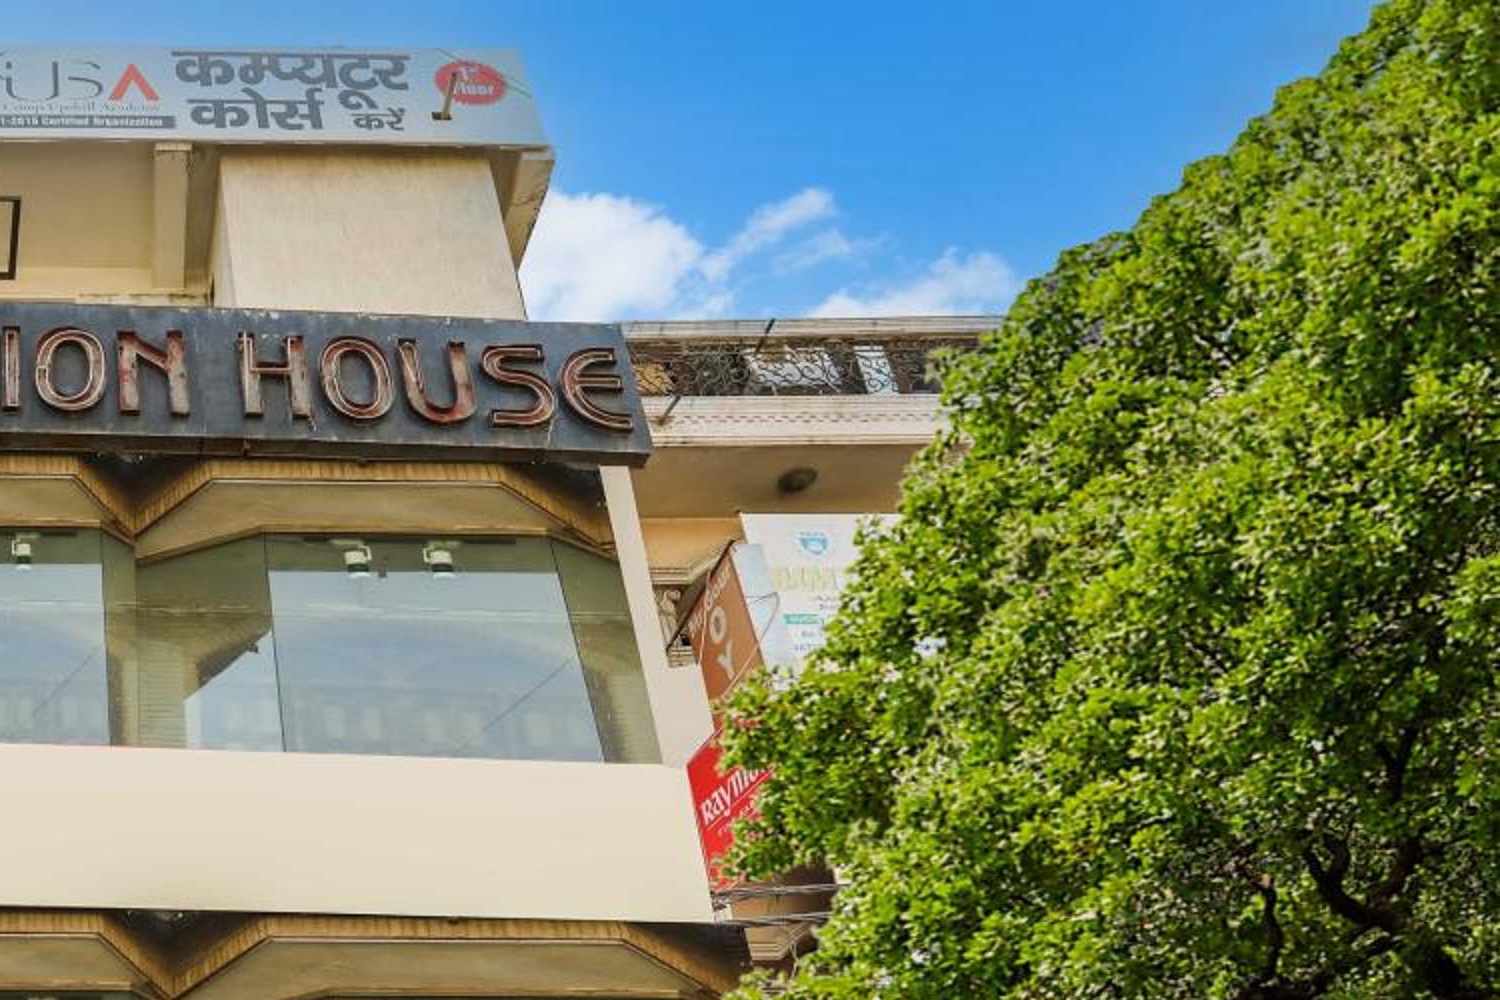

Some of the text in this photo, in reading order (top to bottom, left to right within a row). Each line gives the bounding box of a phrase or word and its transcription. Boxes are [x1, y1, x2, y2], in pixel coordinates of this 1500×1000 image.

[187, 87, 405, 130] कोर्स करें
[235, 330, 634, 432] HOUSE
